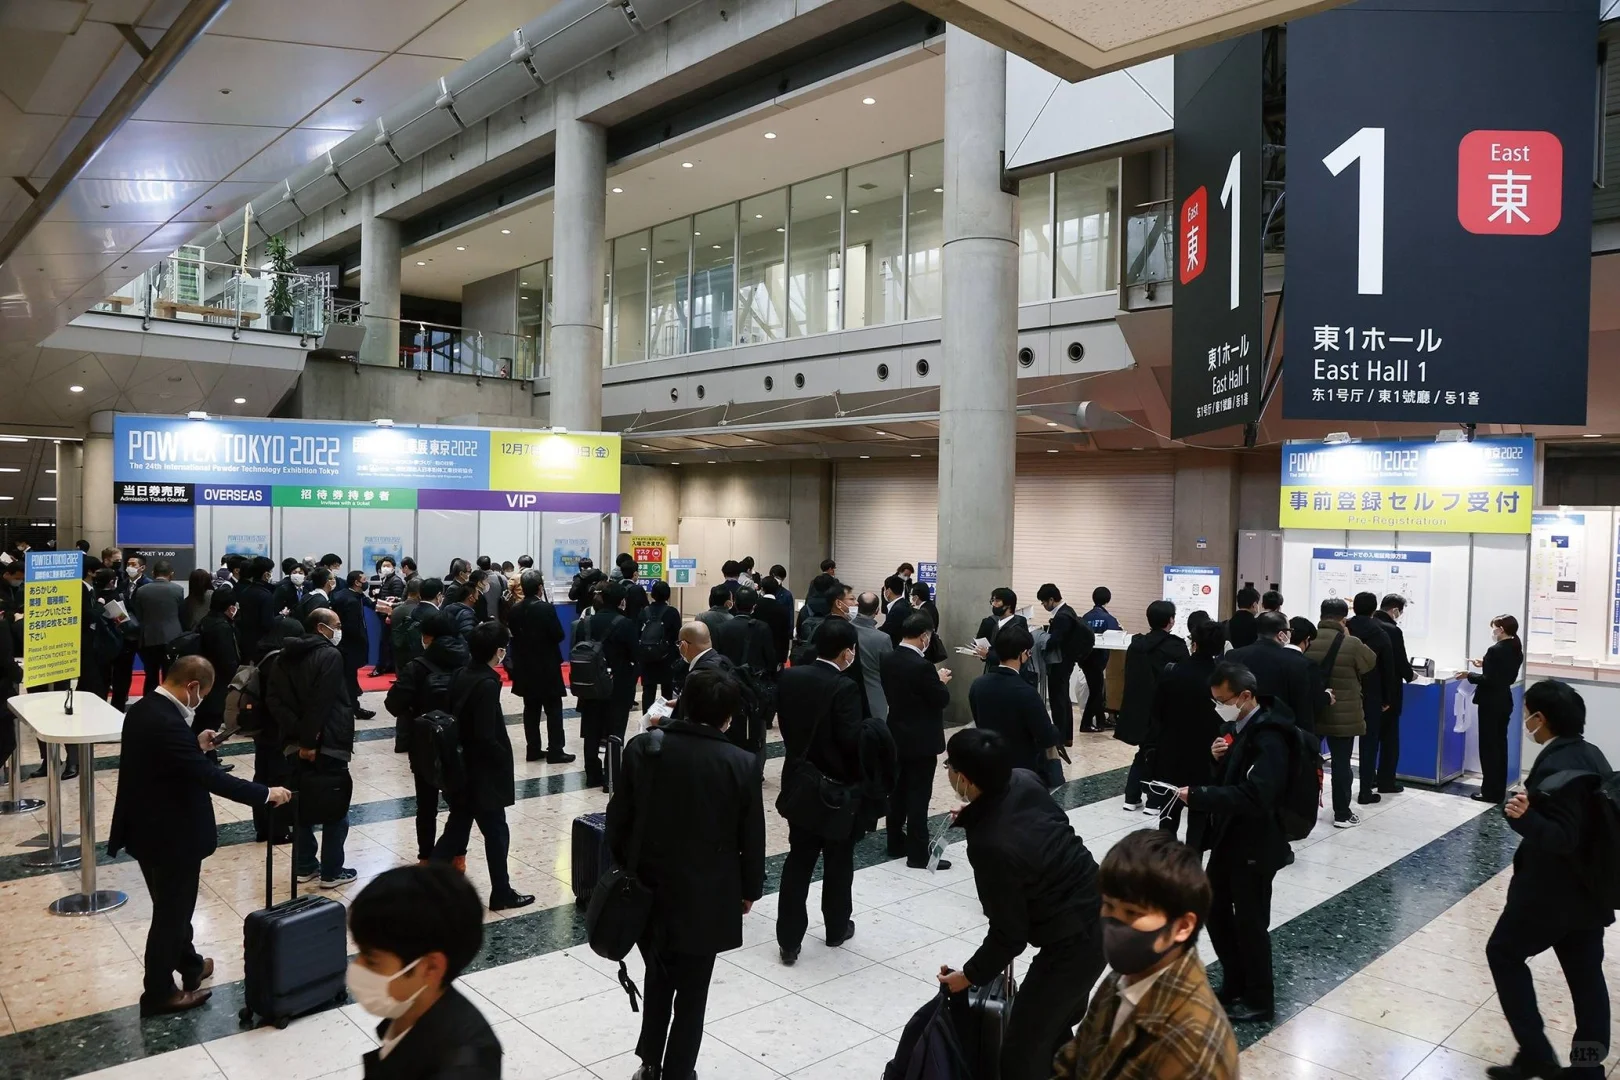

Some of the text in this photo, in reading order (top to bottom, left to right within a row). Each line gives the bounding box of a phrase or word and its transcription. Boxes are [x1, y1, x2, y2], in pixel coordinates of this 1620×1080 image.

[1491, 143, 1530, 162] East
[1487, 169, 1532, 224] 東
[1187, 202, 1199, 224] East
[1322, 127, 1385, 295] 1
[1219, 150, 1241, 311] 1
[1186, 225, 1199, 273] 東
[1313, 324, 1443, 352] 東1ホール
[1207, 333, 1250, 371] 東1ホール
[1212, 364, 1250, 396] East Hall 1
[1314, 358, 1427, 382] East Hall 1
[1312, 387, 1365, 403] 东1号厅
[1444, 390, 1480, 406] 동1홀
[222, 433, 285, 465] TOKYO
[289, 436, 340, 466] 2022
[129, 462, 340, 476] The 24th International Powder Technology Exhibition Tokyo
[1384, 450, 1419, 471] 2022
[123, 484, 186, 498] 当日券売所
[204, 488, 263, 502] OVERSEAS
[300, 488, 390, 501] 招待券持参者
[505, 493, 537, 508] VIP
[1289, 490, 1520, 514] 事前登録セルフ受付
[1347, 515, 1447, 527] Pre-Registration
[29, 585, 58, 595] あらかじめ
[29, 606, 72, 618] チェックいただき
[29, 632, 46, 642] 下さい
